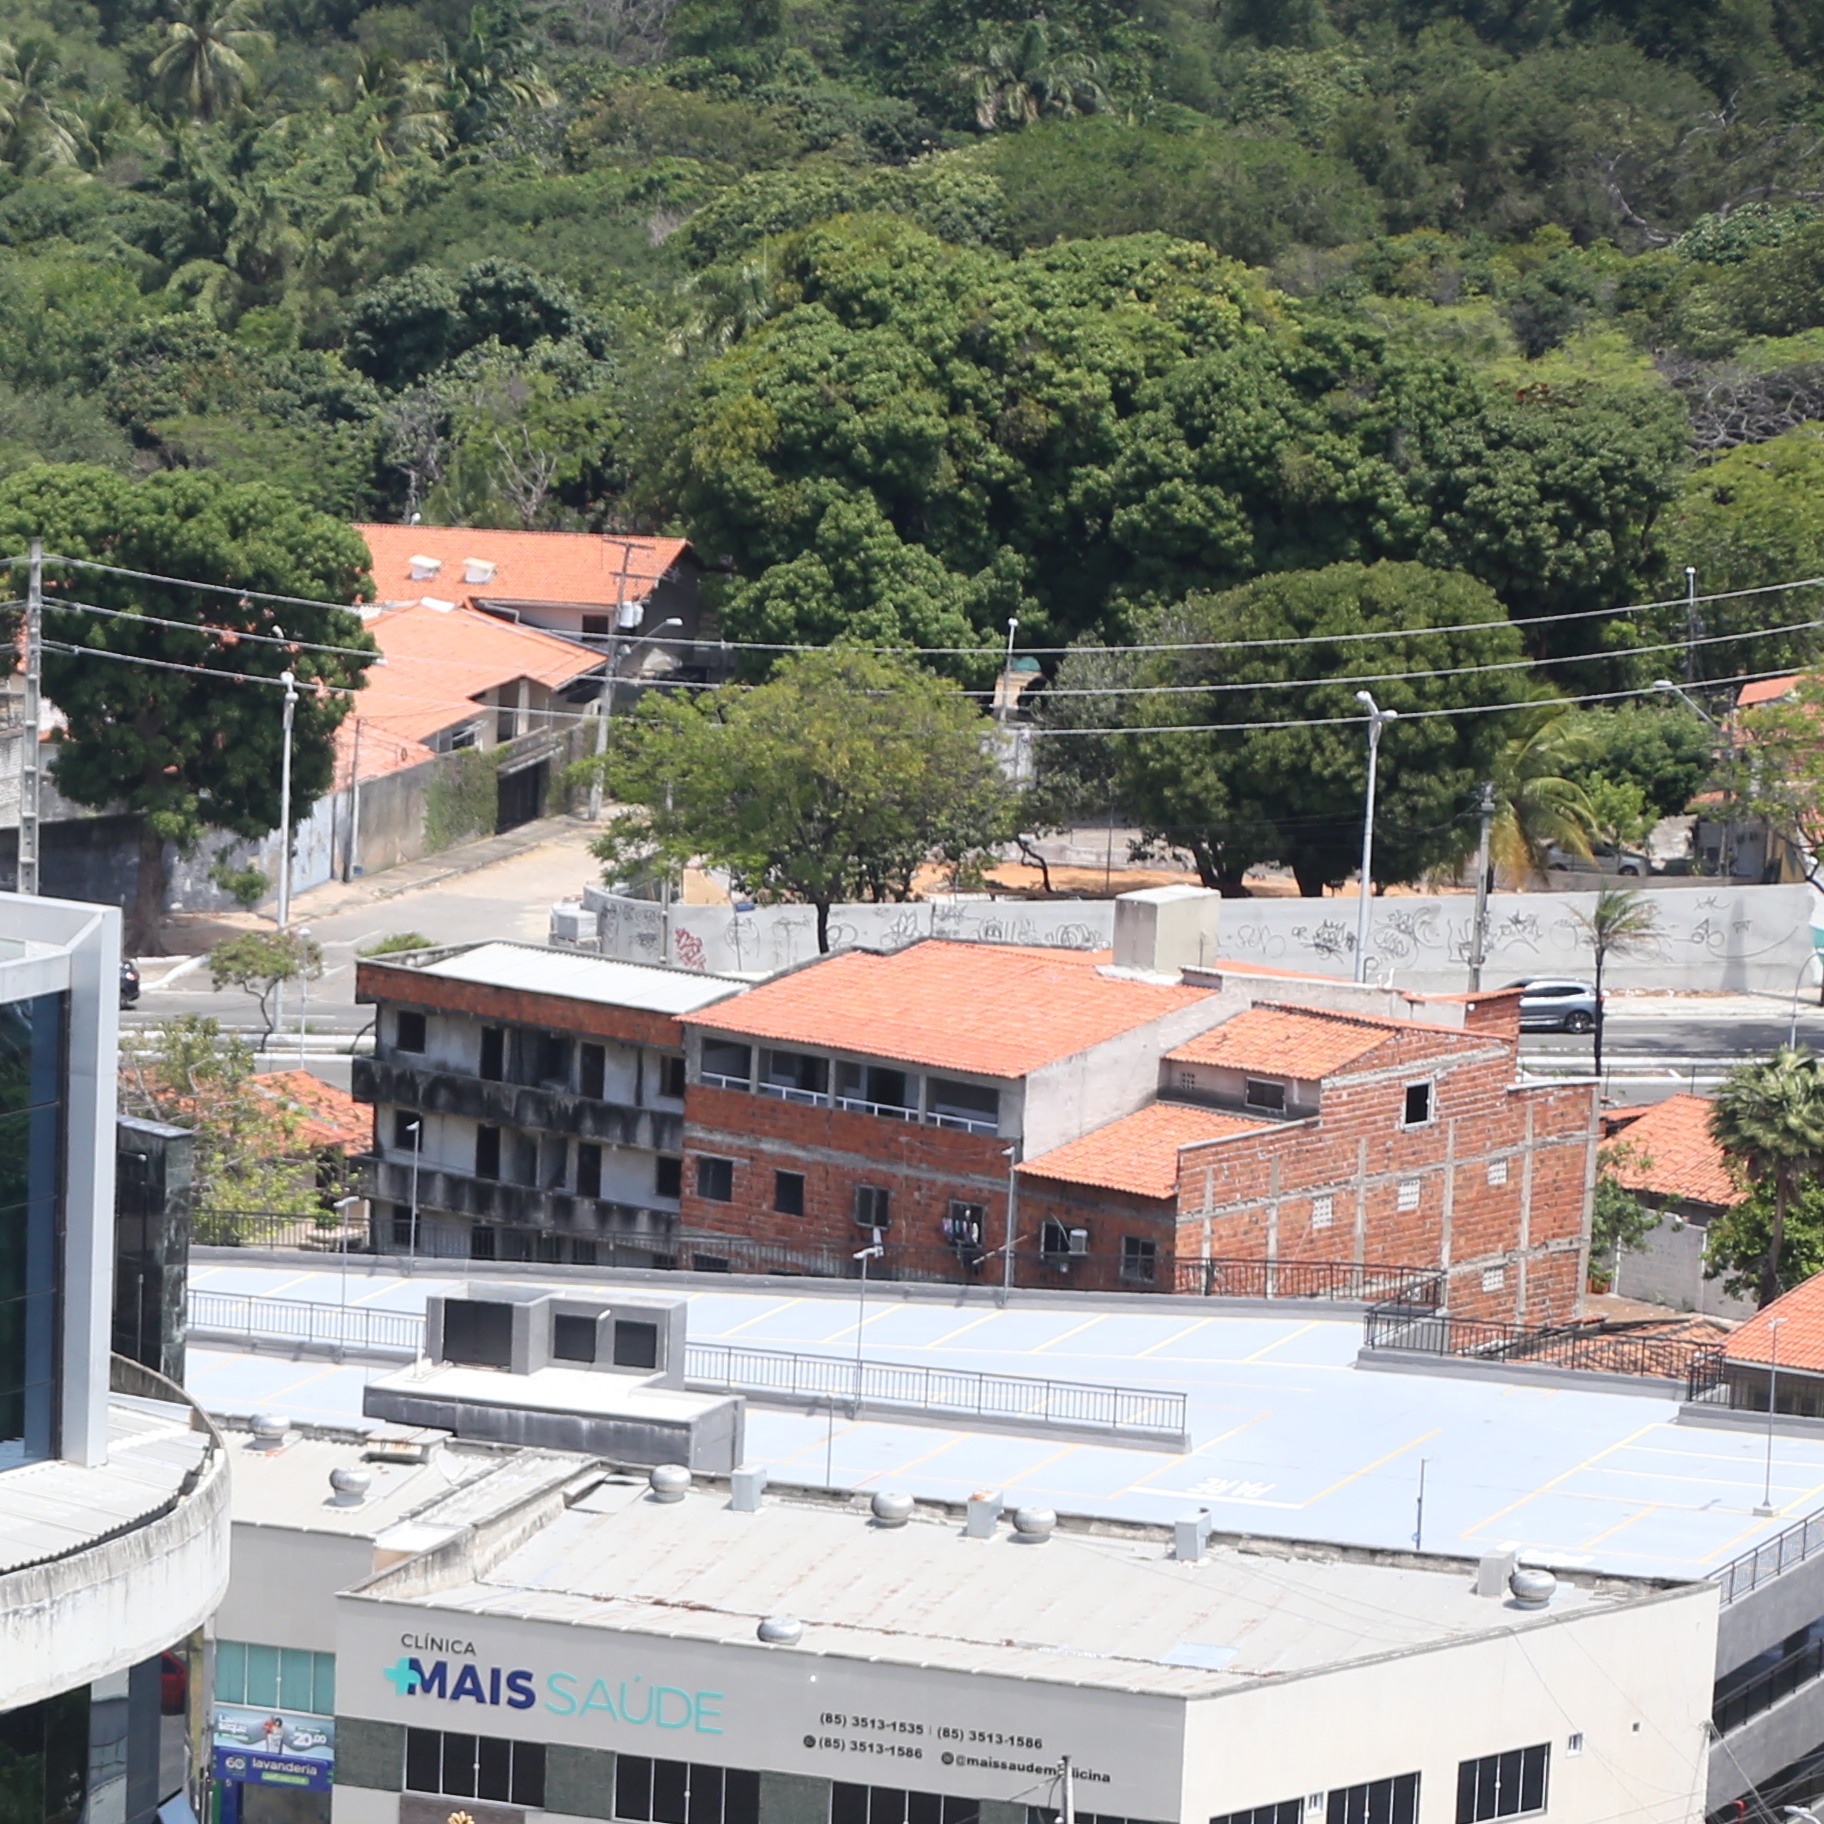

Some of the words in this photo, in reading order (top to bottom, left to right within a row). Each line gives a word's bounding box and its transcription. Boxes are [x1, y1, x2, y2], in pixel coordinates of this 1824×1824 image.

[401, 1633, 477, 1656] CLÍNICA
[407, 1657, 536, 1710] MAIS
[545, 1671, 725, 1734] SAÚDE
[819, 1712, 847, 1728] (85)
[851, 1716, 924, 1735] 3513-1535
[937, 1726, 964, 1742] (85)
[969, 1730, 1043, 1749] 3513-1586
[819, 1736, 846, 1753] (85)
[850, 1740, 923, 1759] 3513-1586
[252, 1757, 318, 1775] lavanderia
[955, 1754, 1110, 1783] @maissaudemicina
